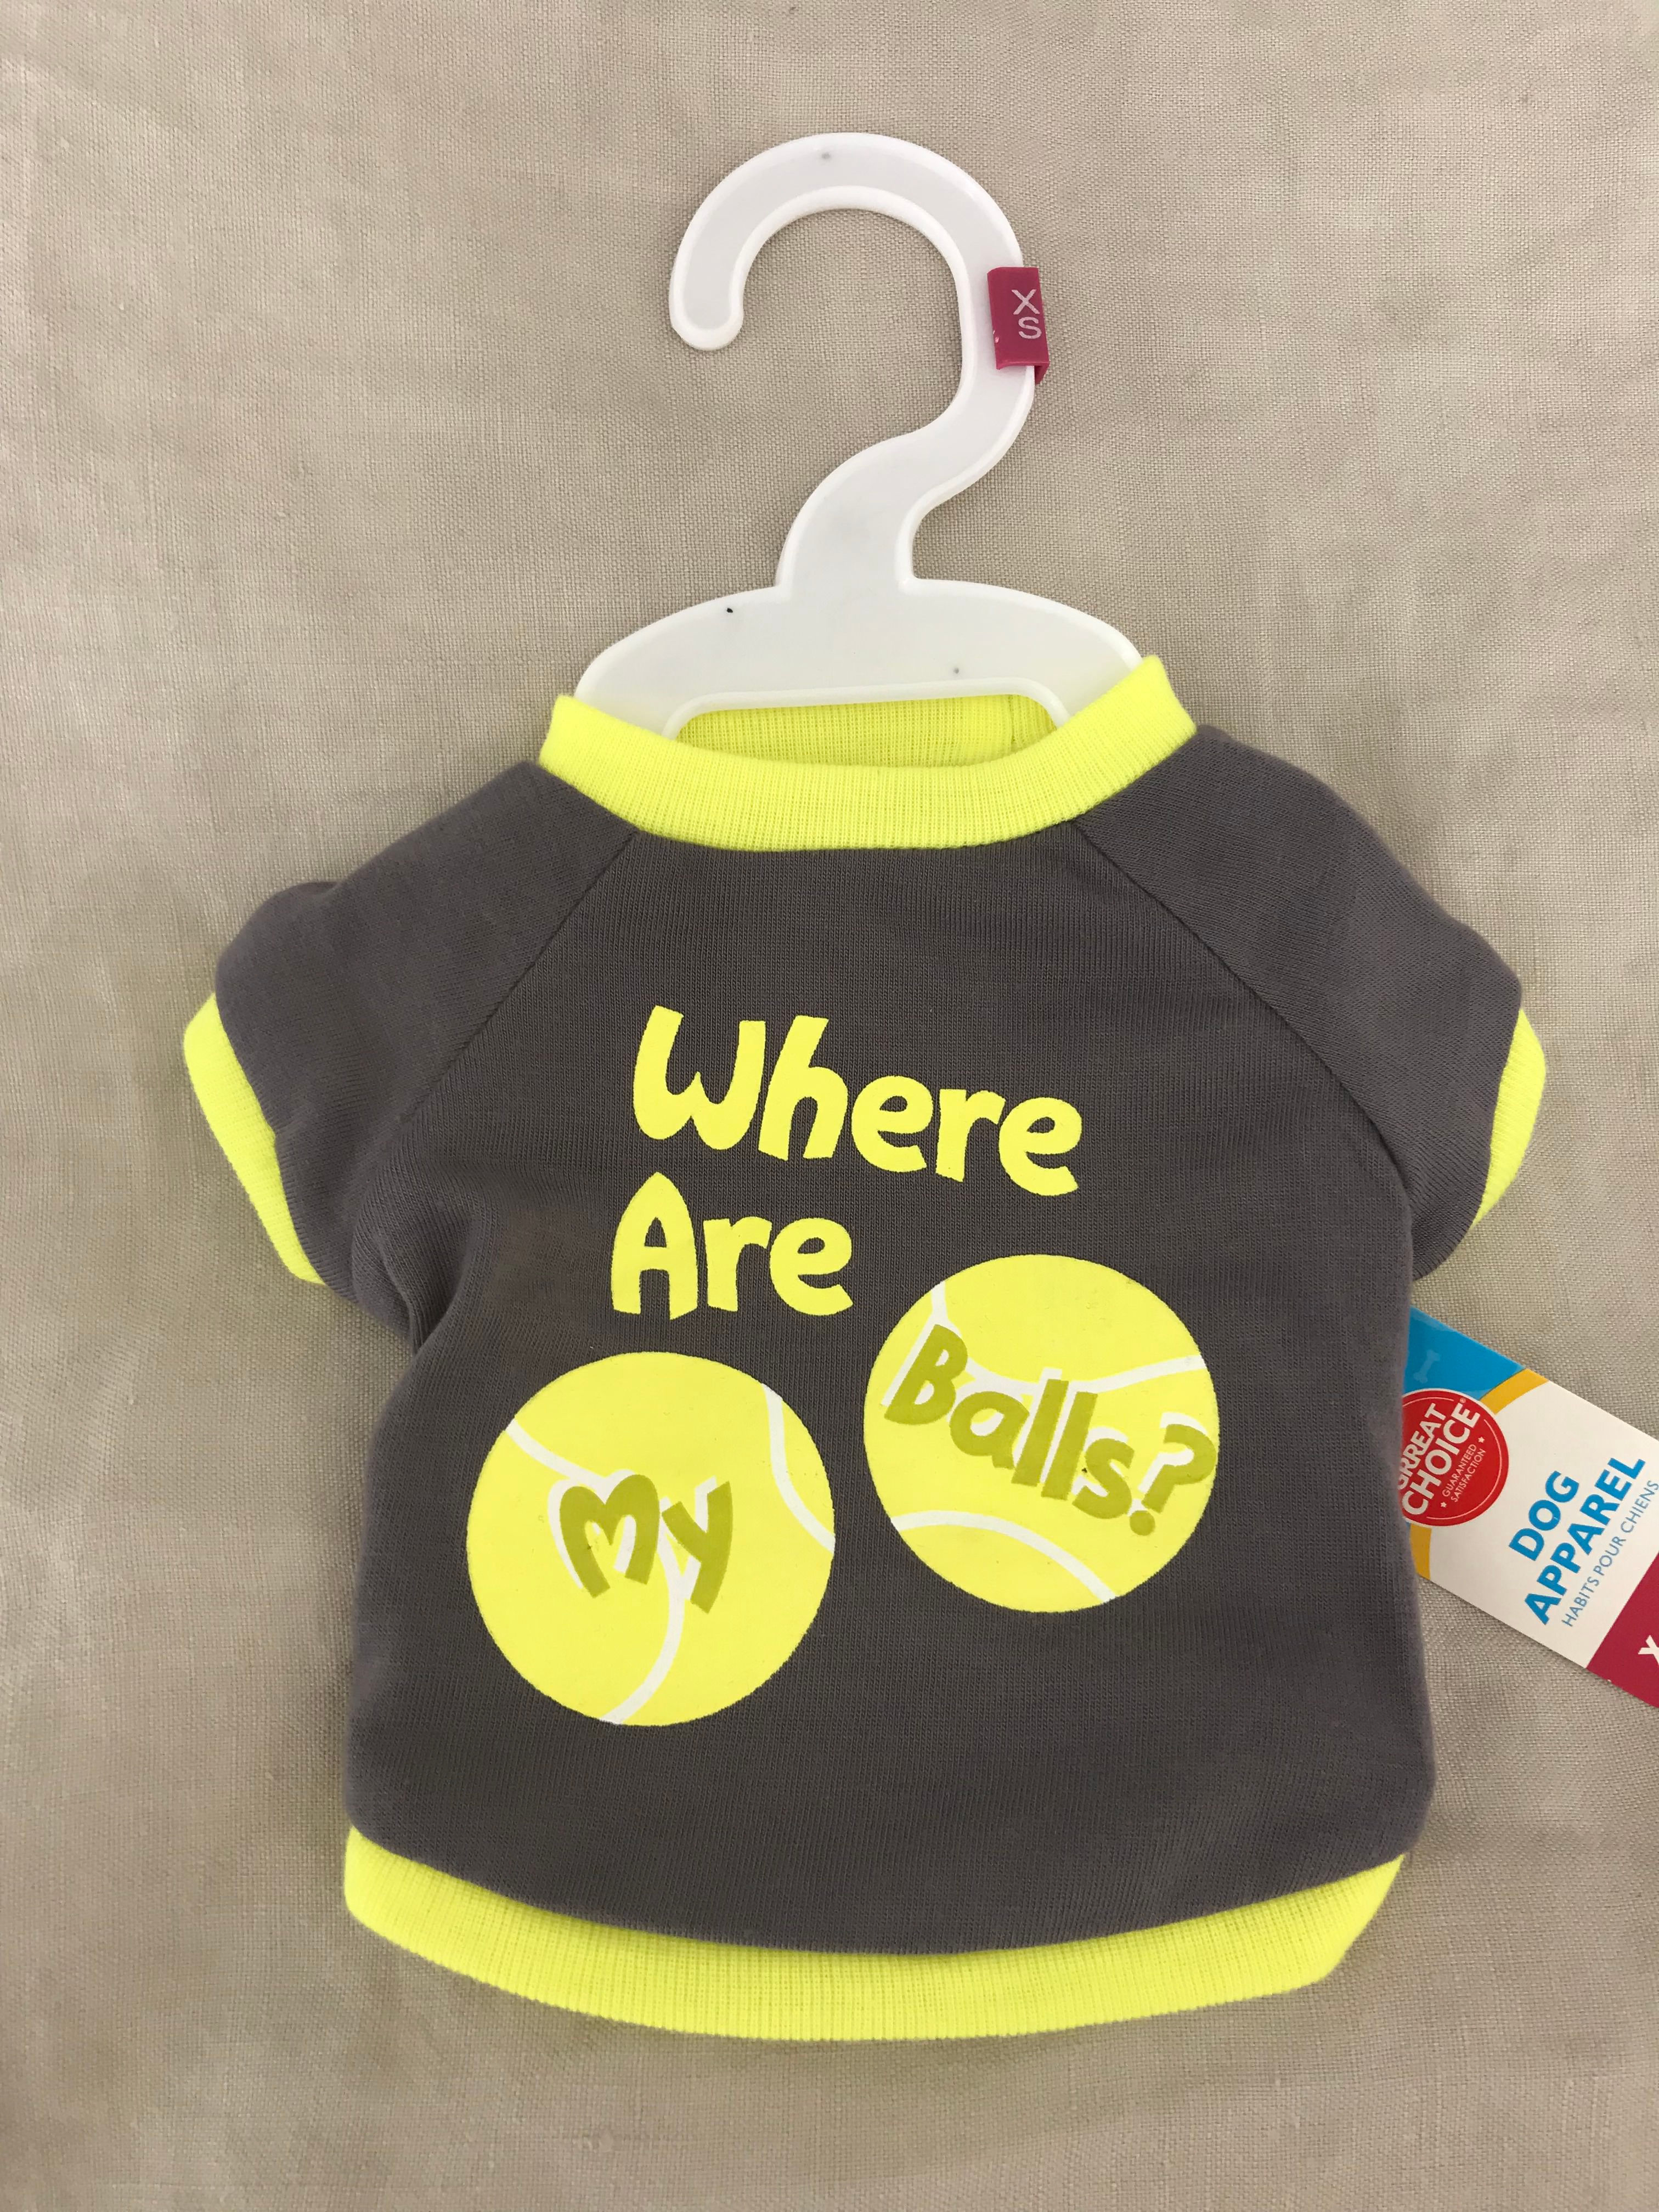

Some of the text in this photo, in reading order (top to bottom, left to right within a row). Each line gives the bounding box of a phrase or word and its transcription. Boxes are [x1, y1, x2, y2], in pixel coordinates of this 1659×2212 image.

[633, 1005, 1083, 1196] Where
[611, 1171, 854, 1320] Are
[884, 1324, 1217, 1537] Balls?
[1442, 1443, 1477, 1497] GUARANTEED
[1451, 1448, 1486, 1503] SATISFACTION
[558, 1473, 733, 1613] My
[1508, 1470, 1580, 1561] DOG
[1524, 1457, 1646, 1626] APPAREL
[1561, 1480, 1659, 1627] HABITS POUR CHIENS
